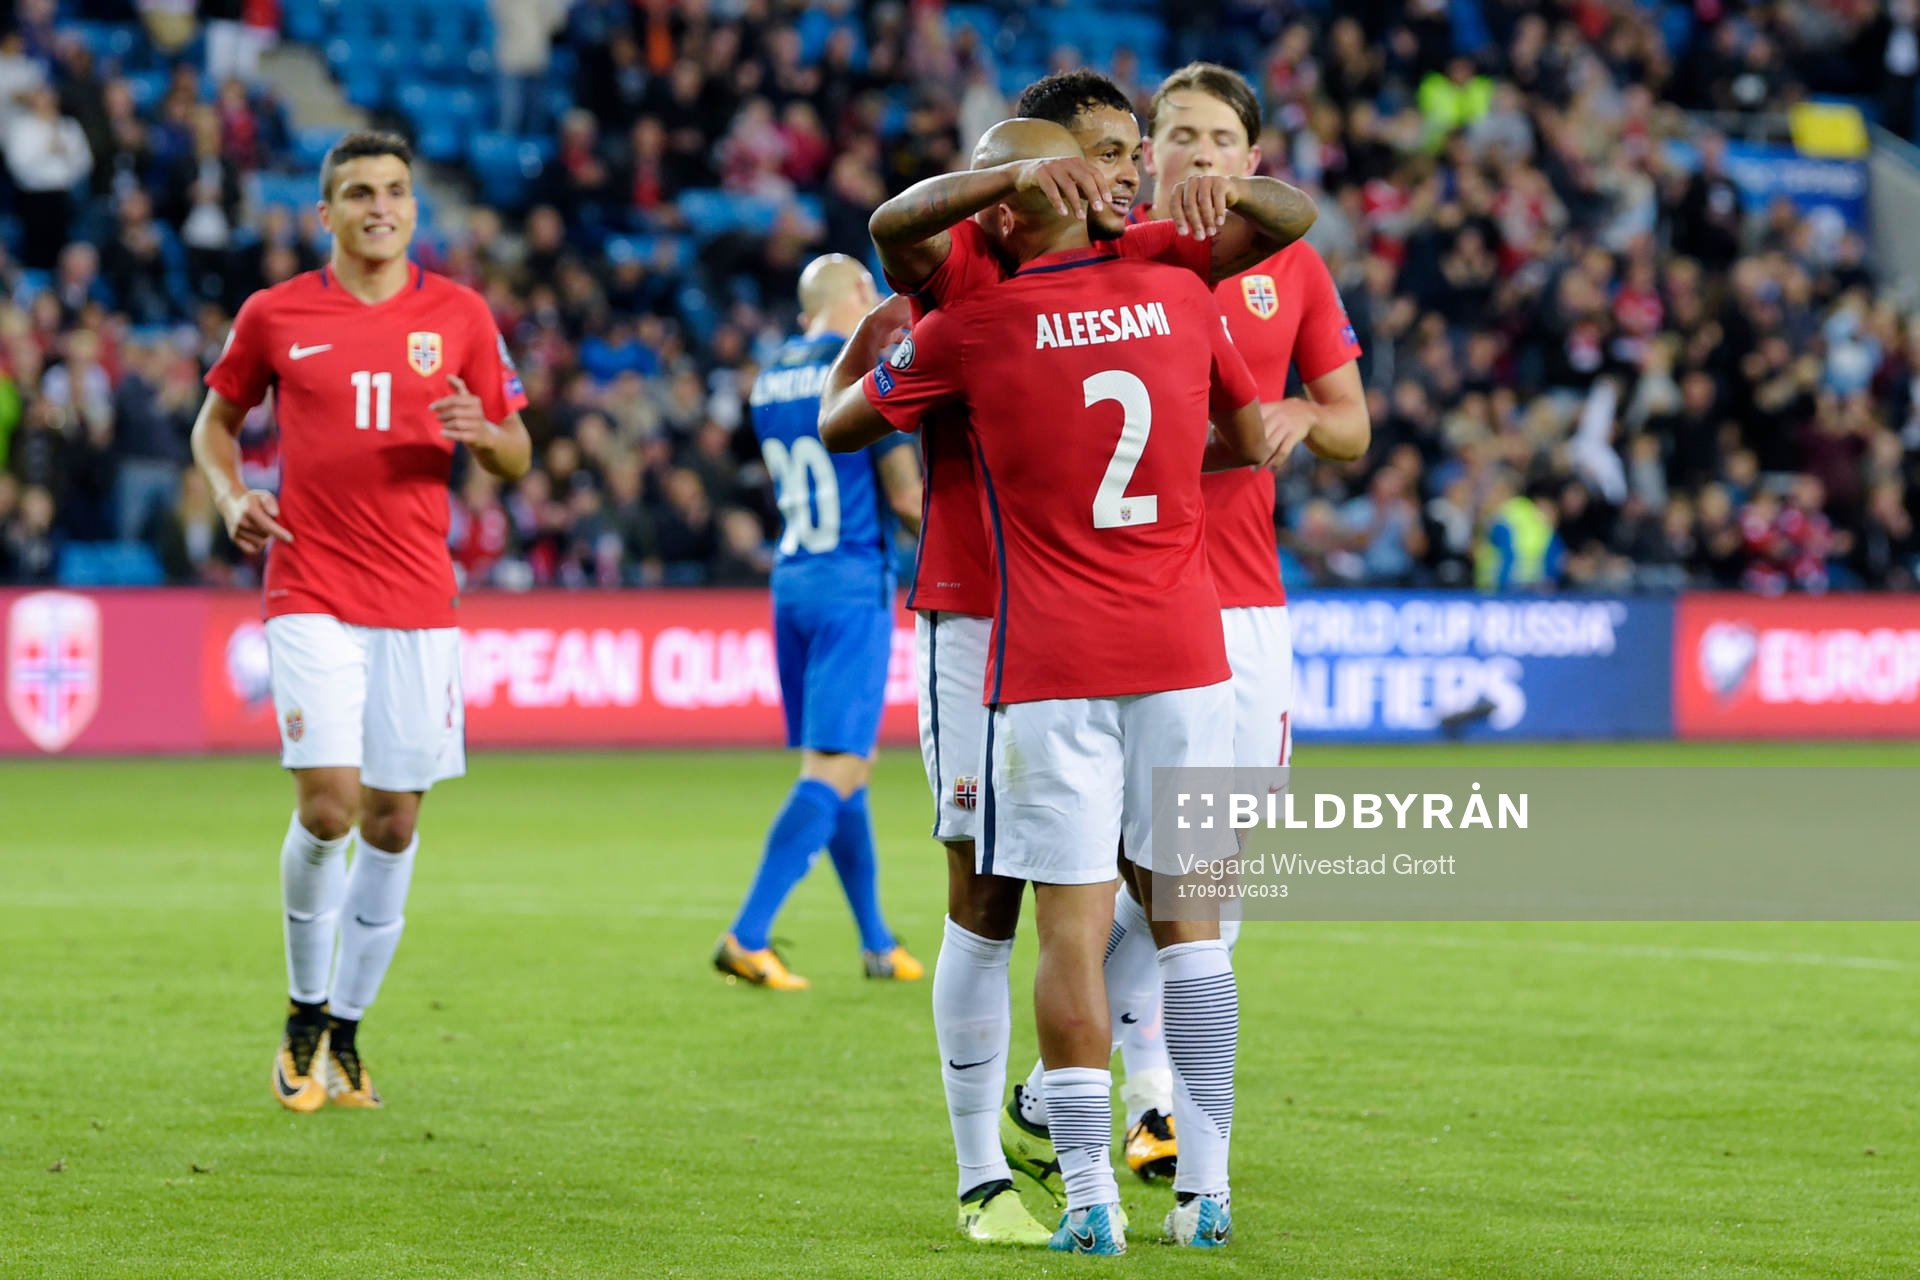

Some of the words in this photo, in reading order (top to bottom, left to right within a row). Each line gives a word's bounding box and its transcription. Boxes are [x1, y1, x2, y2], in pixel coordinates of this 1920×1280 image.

[1035, 301, 1171, 350] ALEESAMI
[350, 370, 393, 432] 11
[1082, 369, 1158, 529] 2
[1290, 599, 1396, 655] ORLD
[1400, 599, 1472, 655] CUP
